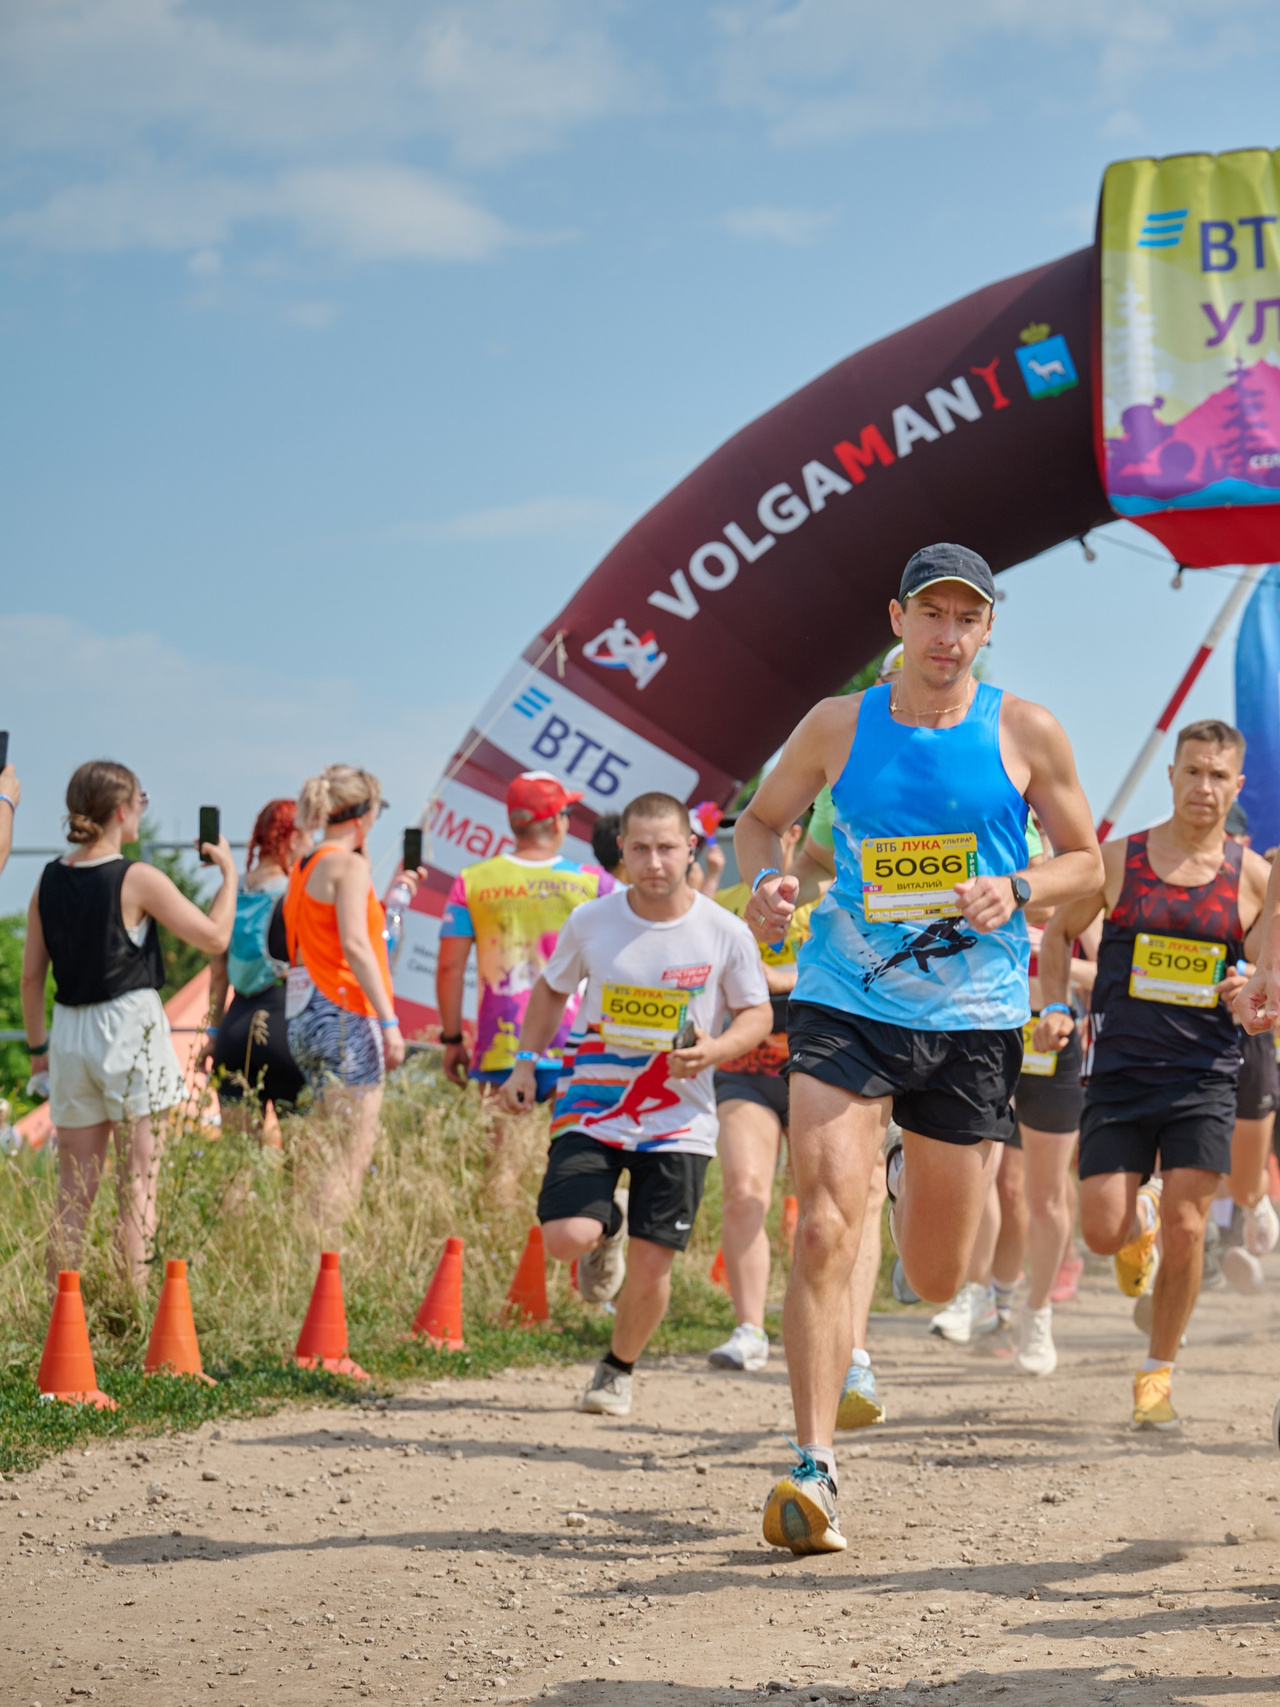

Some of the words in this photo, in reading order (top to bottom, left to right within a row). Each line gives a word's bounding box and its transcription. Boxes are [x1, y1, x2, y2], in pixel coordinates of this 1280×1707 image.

[530, 714, 632, 798] ВТБ
[876, 842, 897, 853] ВТБ
[901, 840, 941, 851] ЛУКА
[875, 855, 963, 878] 5066
[896, 879, 943, 890] ВИТАЛИЙ
[1148, 952, 1208, 973] 5109
[610, 998, 677, 1019] 5000
